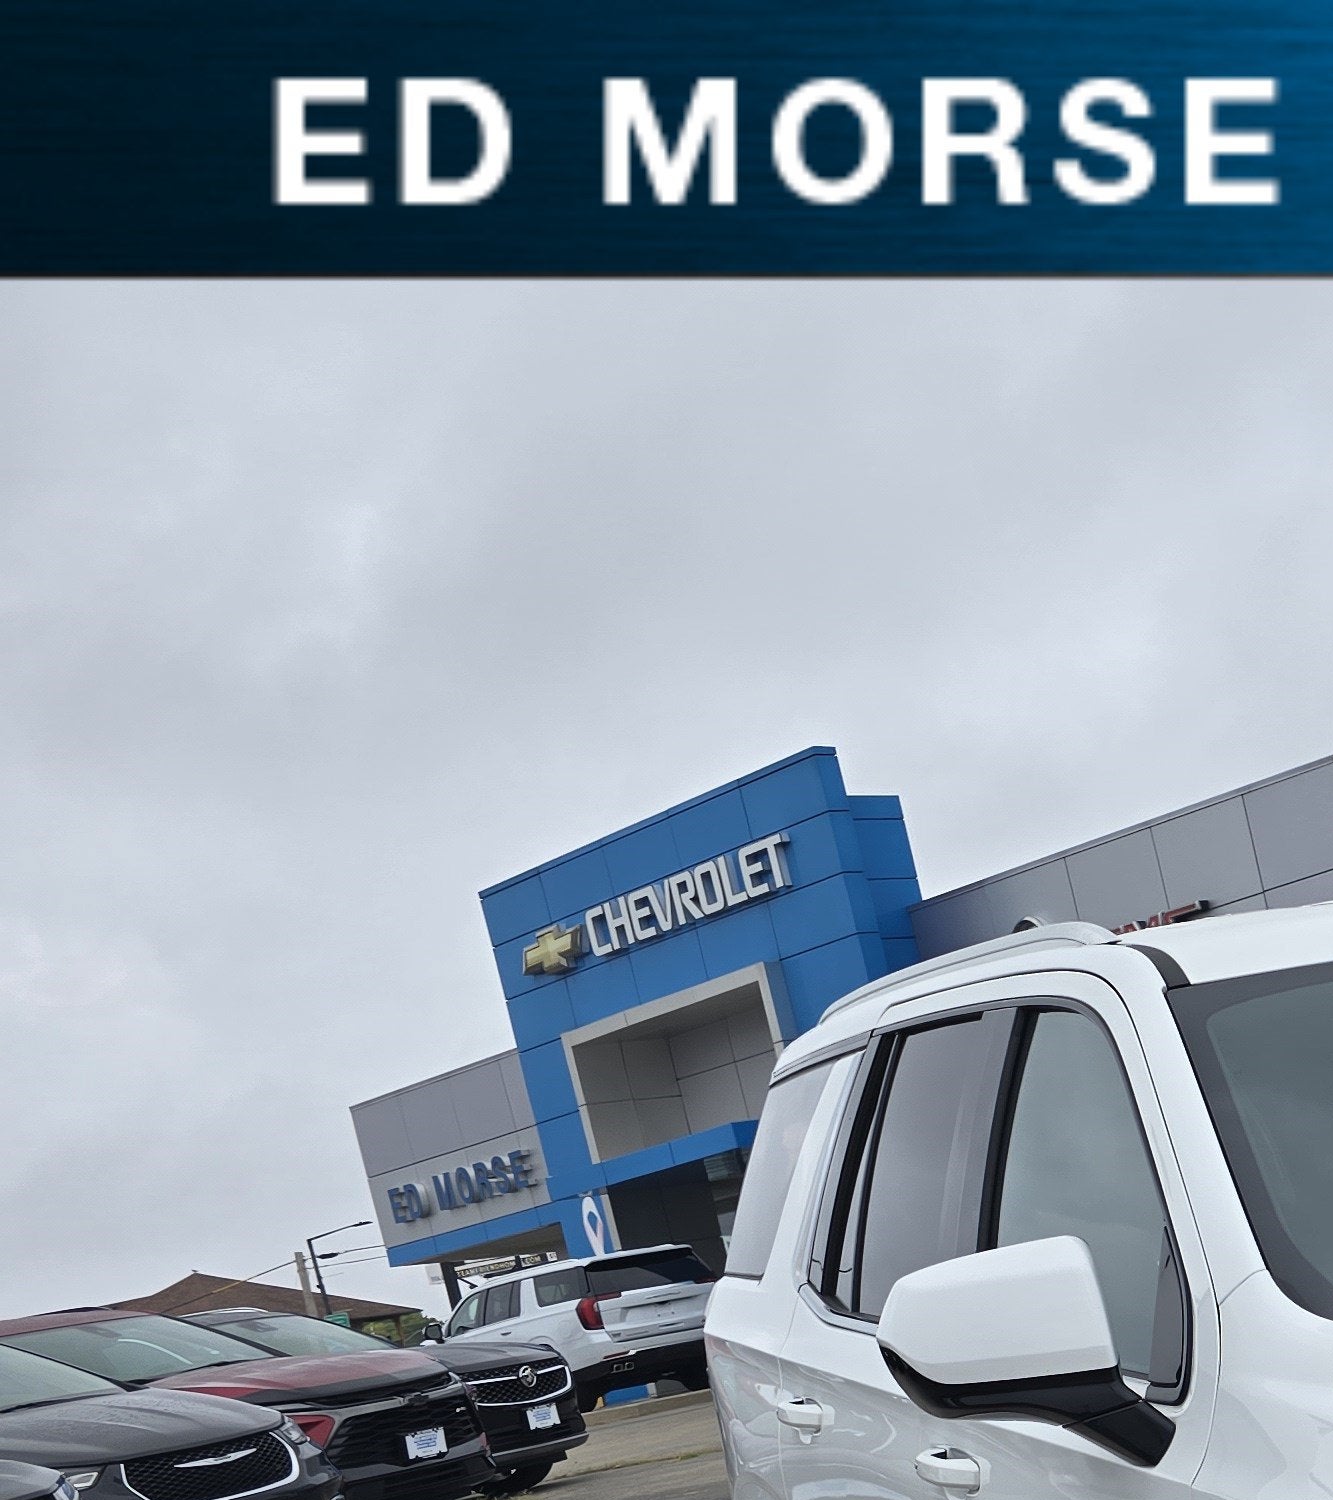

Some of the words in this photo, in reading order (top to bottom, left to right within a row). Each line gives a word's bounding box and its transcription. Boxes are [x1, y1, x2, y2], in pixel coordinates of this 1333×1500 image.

[585, 833, 791, 957] CHEVROLET
[387, 1183, 426, 1224] ED
[432, 1150, 534, 1211] MORSE
